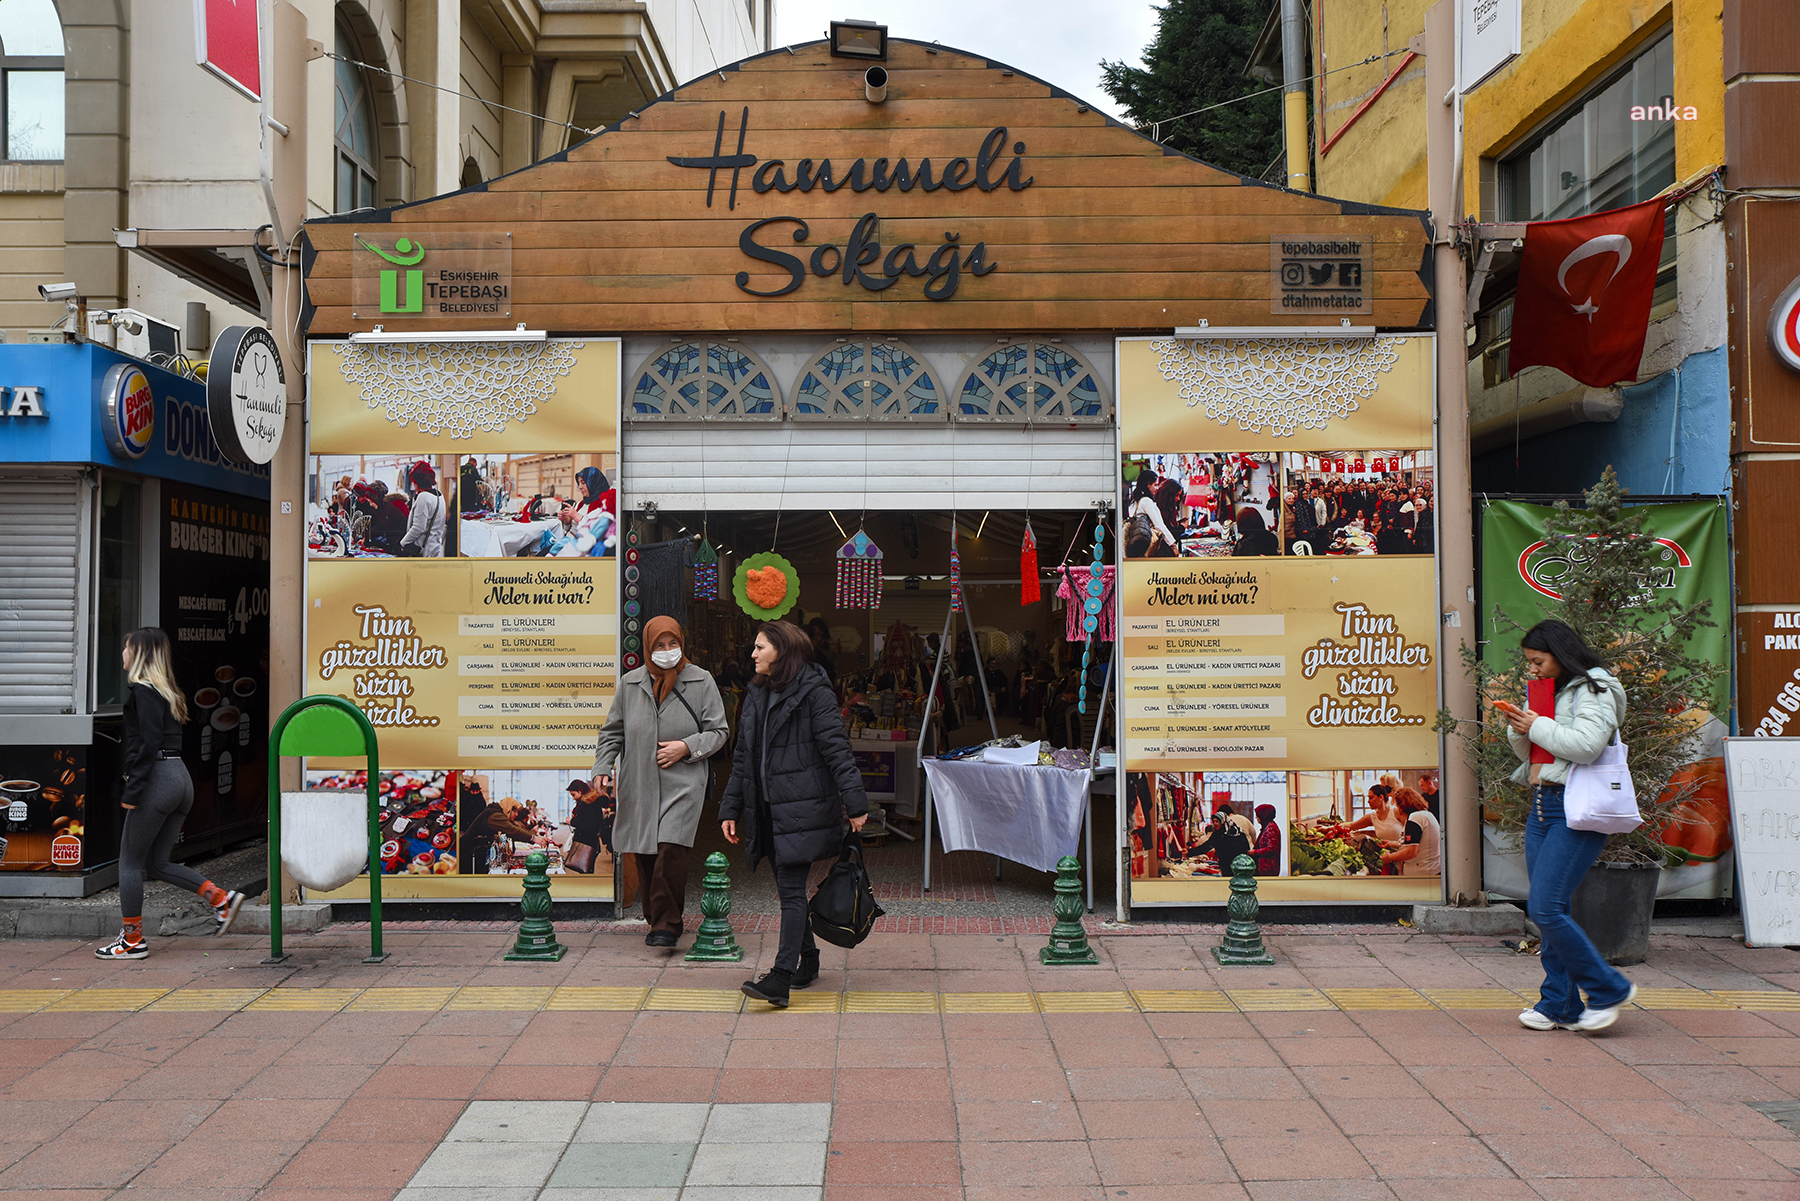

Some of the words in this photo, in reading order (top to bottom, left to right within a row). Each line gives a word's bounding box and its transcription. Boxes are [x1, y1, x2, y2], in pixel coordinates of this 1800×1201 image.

[666, 106, 1034, 211] Hanımeli
[735, 212, 997, 300] Sokağı
[1281, 241, 1361, 257] tepebasibeltr
[427, 283, 508, 301] TEPEBAŞI
[1282, 294, 1362, 308] dtahmetatac
[440, 302, 499, 313] BELEDİYESİ
[235, 380, 281, 415] Hanımeli
[246, 415, 276, 443] Sokağı
[170, 521, 224, 555] BURGER
[484, 571, 533, 585] Hanımeli
[534, 571, 593, 589] Sokağı'nda
[1147, 572, 1197, 585] Hanımeli
[1198, 571, 1257, 589] Sokağı'nda
[179, 594, 207, 610] NESCAFÉ
[207, 597, 226, 611] WHITE
[484, 586, 531, 605] Neler
[533, 589, 555, 604] mi
[557, 586, 594, 604] var?
[1147, 586, 1195, 606] Neler
[1197, 589, 1219, 605] mi
[1221, 585, 1259, 605] var?
[354, 605, 414, 638] Tüm
[513, 617, 556, 627] ÜRÜNLERİ
[1178, 618, 1220, 627] ÜRÜNLERİ
[1335, 603, 1396, 637] Tüm
[178, 625, 206, 641] NESCAFÉ
[206, 628, 226, 641] BLACK
[513, 638, 556, 647] ÜRÜNLERİ
[1166, 640, 1176, 648] EL
[1178, 639, 1221, 648] ÜRÜNLERİ
[321, 637, 446, 678] güzellikler
[1304, 636, 1430, 677] güzellikler
[355, 671, 412, 696] sizin
[1339, 670, 1396, 695] sizin
[1309, 695, 1423, 725] elinizde...
[53, 850, 79, 859] KING
